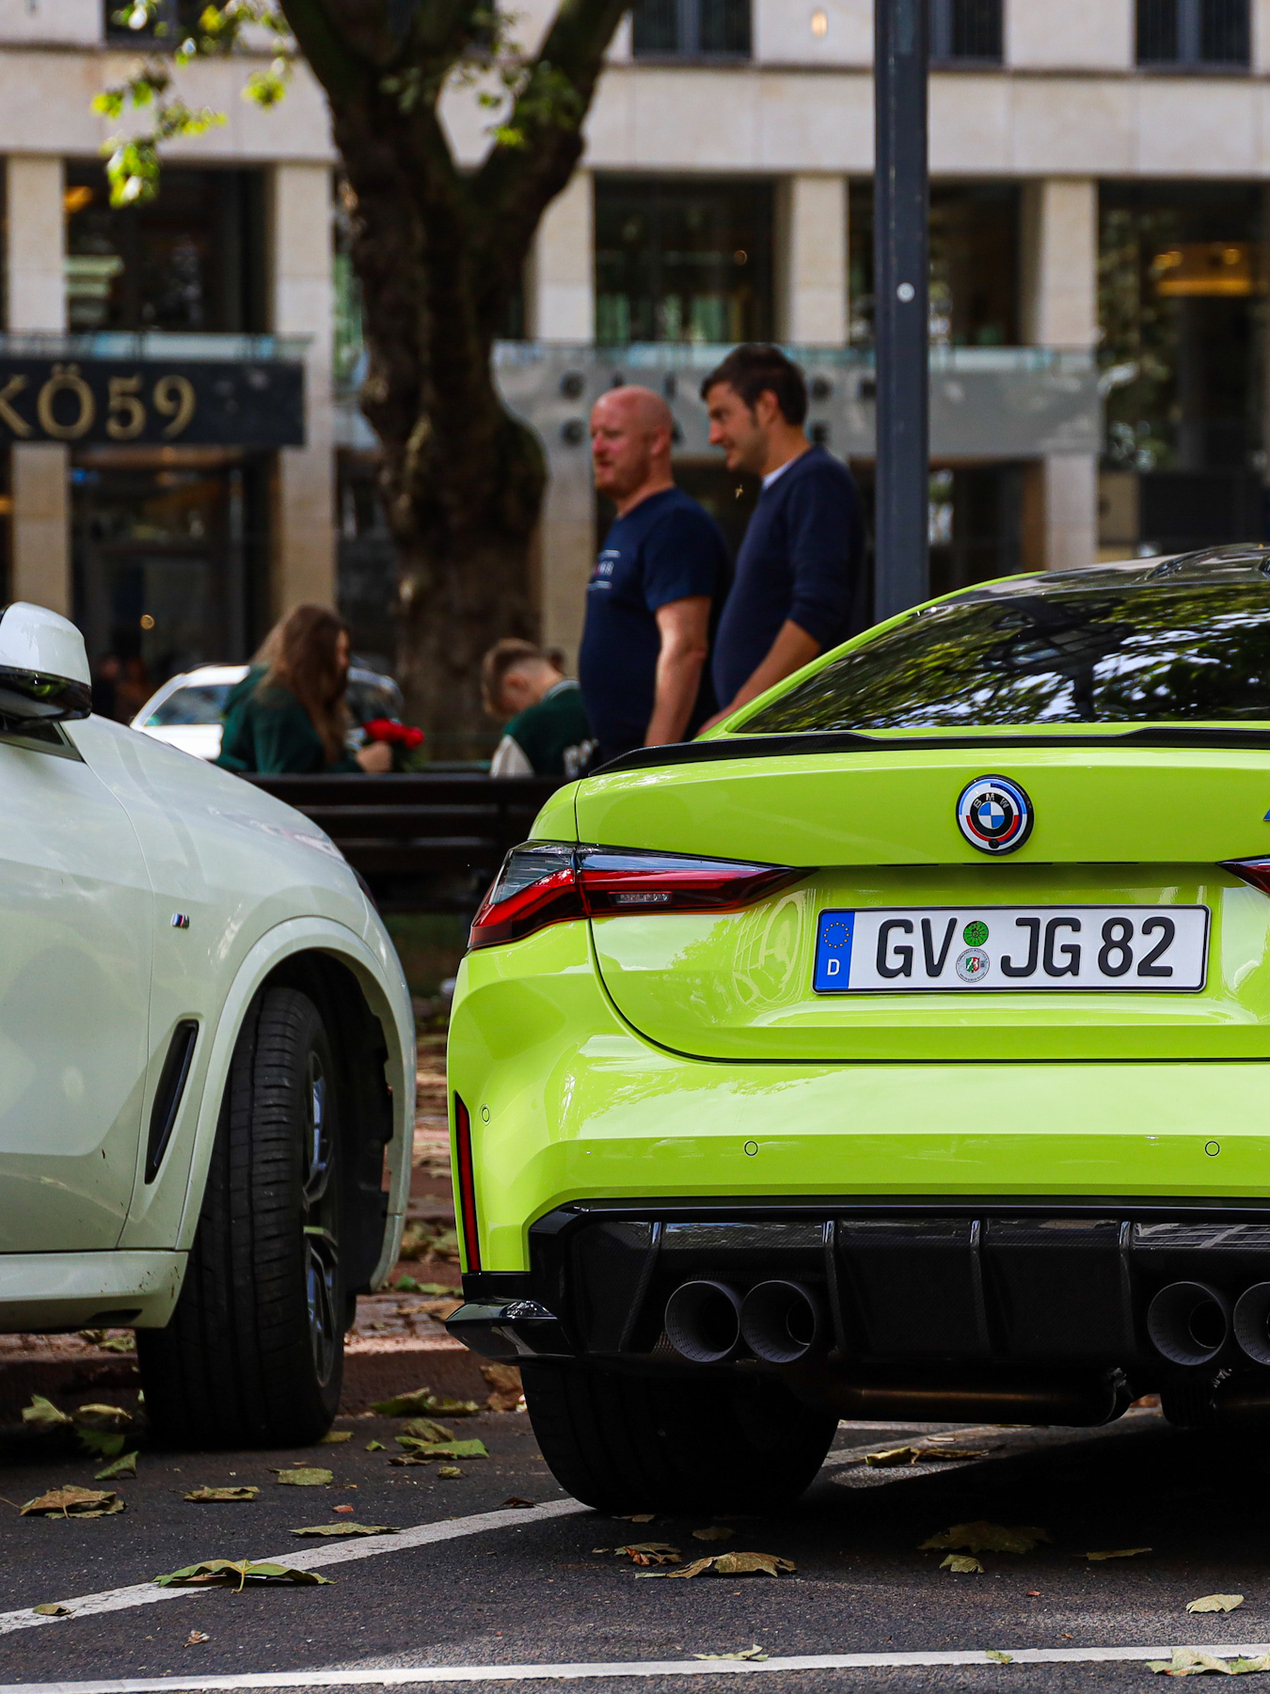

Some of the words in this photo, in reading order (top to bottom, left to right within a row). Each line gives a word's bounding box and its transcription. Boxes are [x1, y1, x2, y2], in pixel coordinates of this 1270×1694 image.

[972, 792, 1010, 810] BMW
[876, 917, 958, 979] GV
[1000, 916, 1082, 978] JG
[1097, 916, 1176, 978] 82
[827, 957, 841, 976] D
